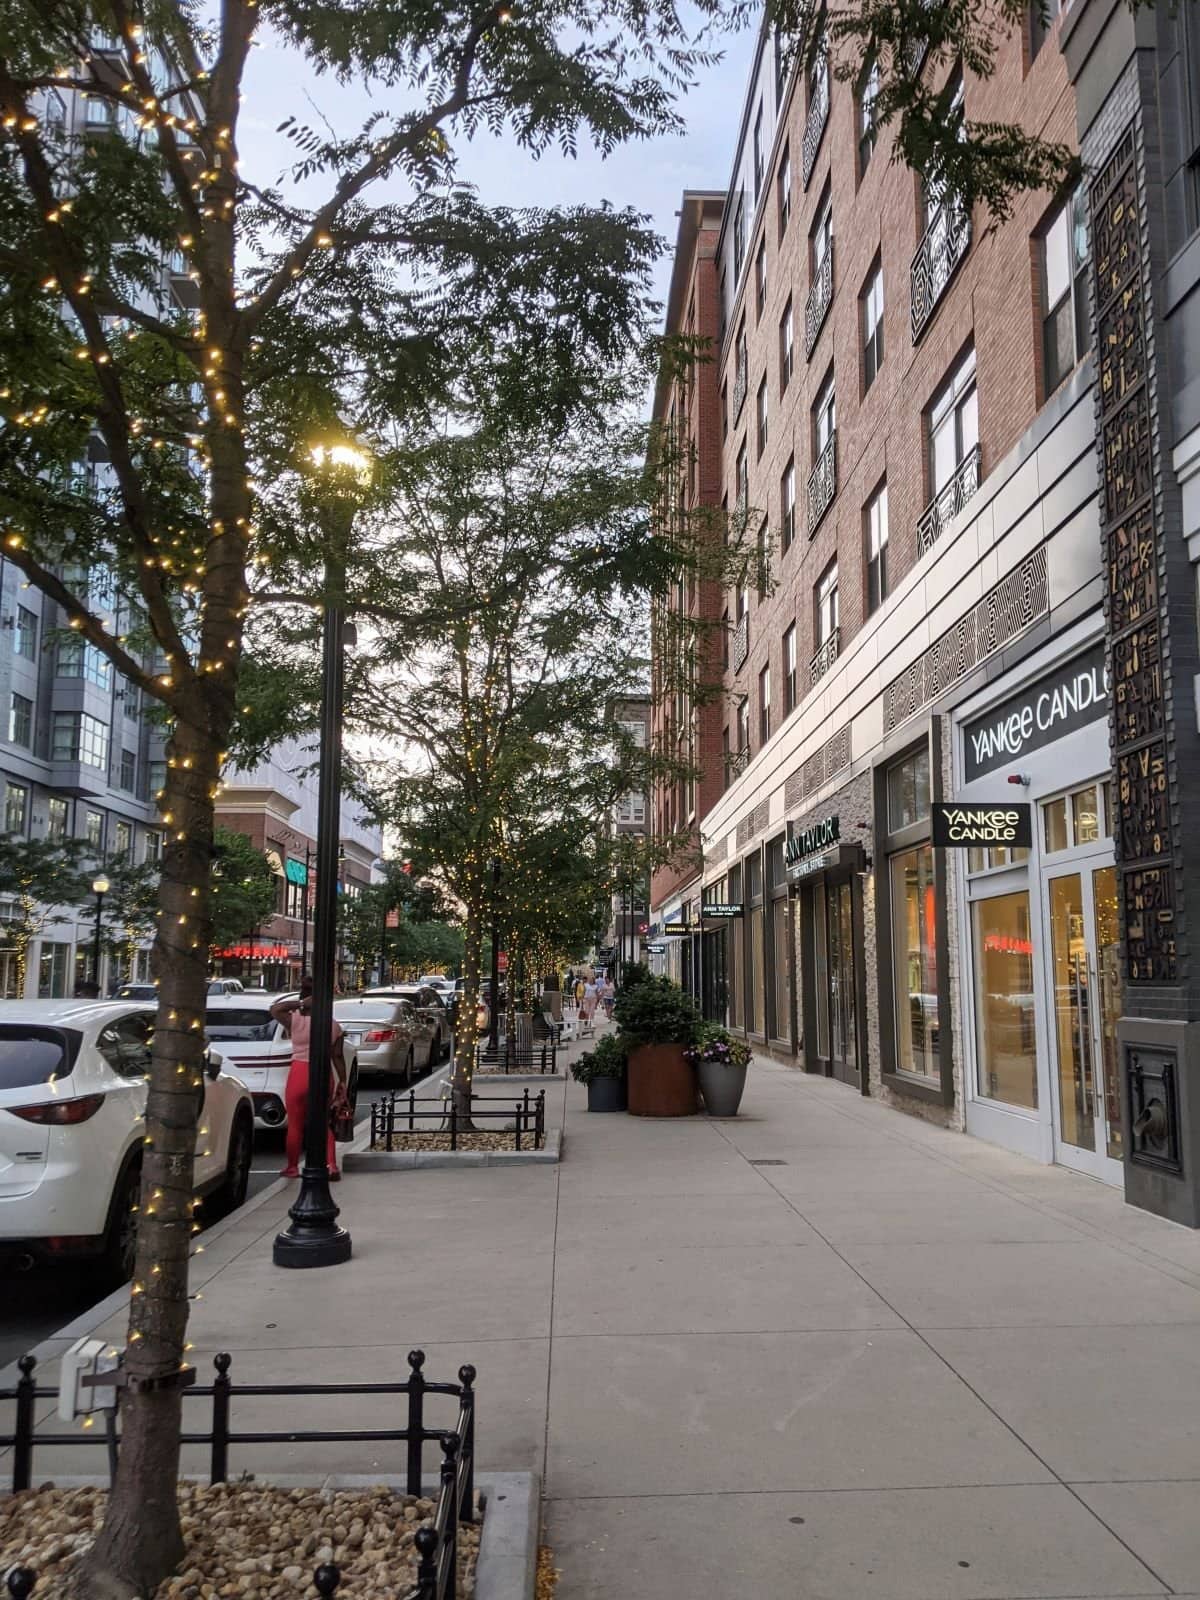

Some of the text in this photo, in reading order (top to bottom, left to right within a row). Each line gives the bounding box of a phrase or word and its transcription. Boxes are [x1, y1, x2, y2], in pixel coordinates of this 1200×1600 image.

[971, 705, 1033, 764] YANKee
[942, 808, 1020, 828] YANKee
[801, 816, 836, 856] TAYLOR
[948, 826, 1016, 841] CANDLe
